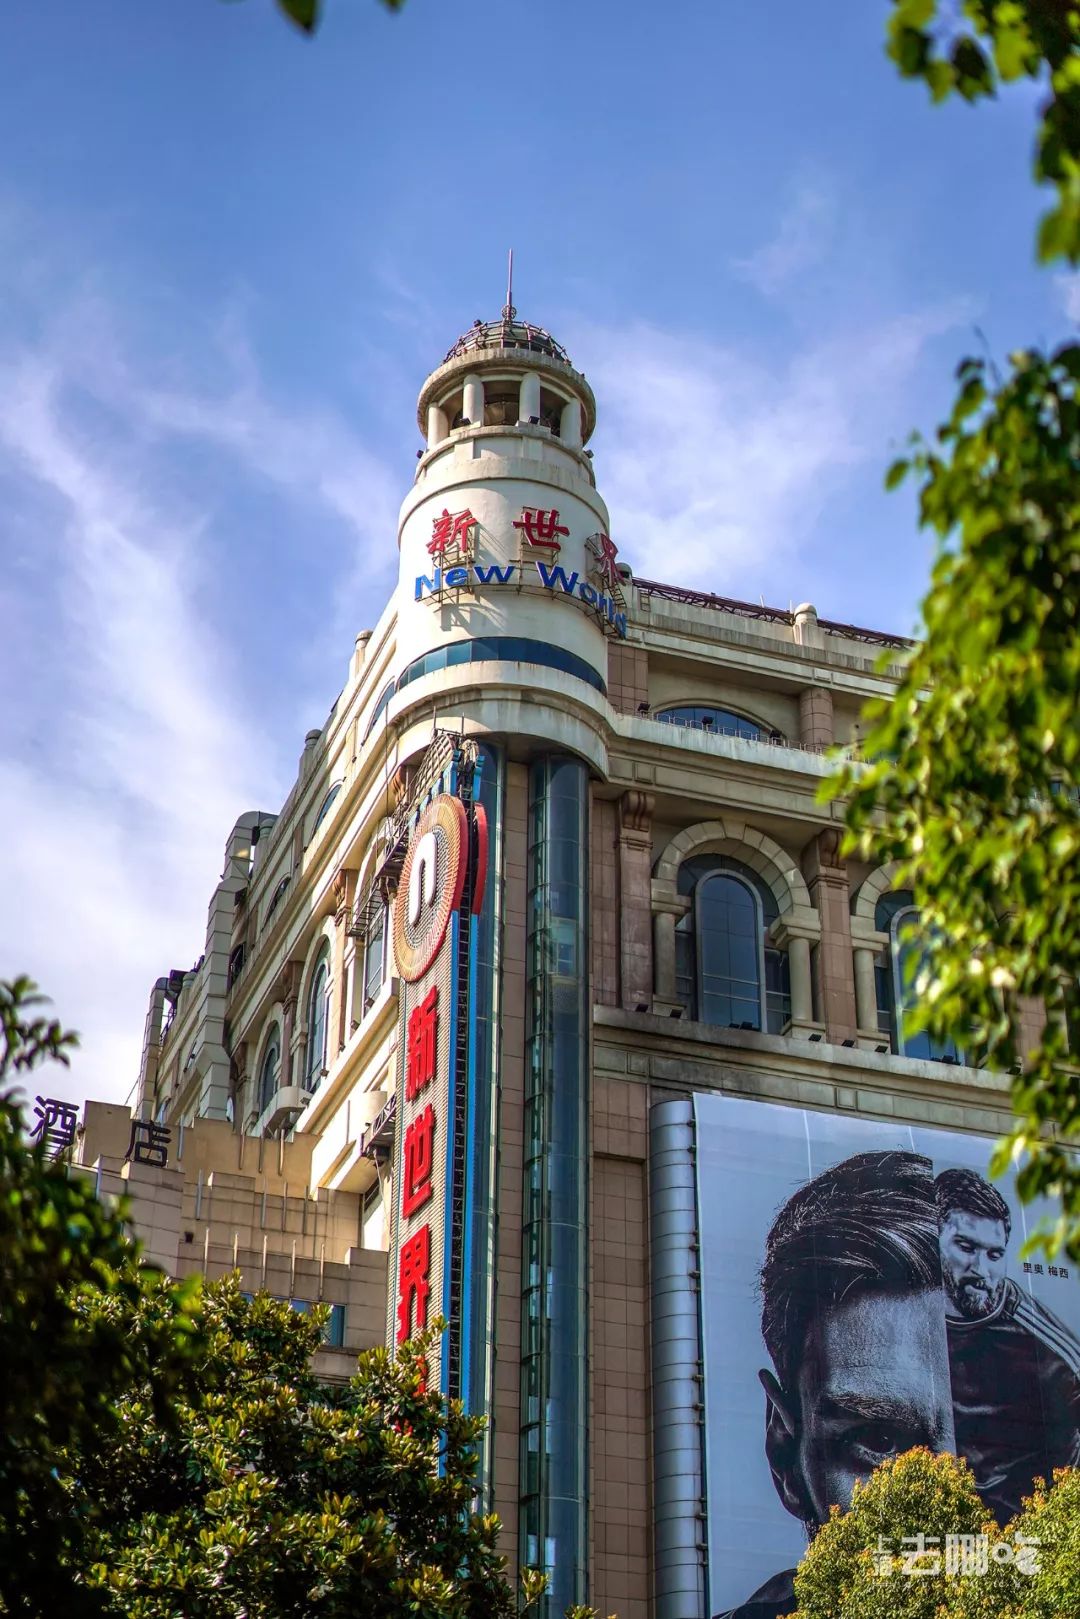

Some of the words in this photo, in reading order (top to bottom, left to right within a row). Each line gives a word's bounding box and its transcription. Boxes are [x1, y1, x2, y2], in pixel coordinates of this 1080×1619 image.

[414, 564, 516, 600] New
[425, 507, 626, 586] 新世界
[30, 1095, 172, 1168] 酒店
